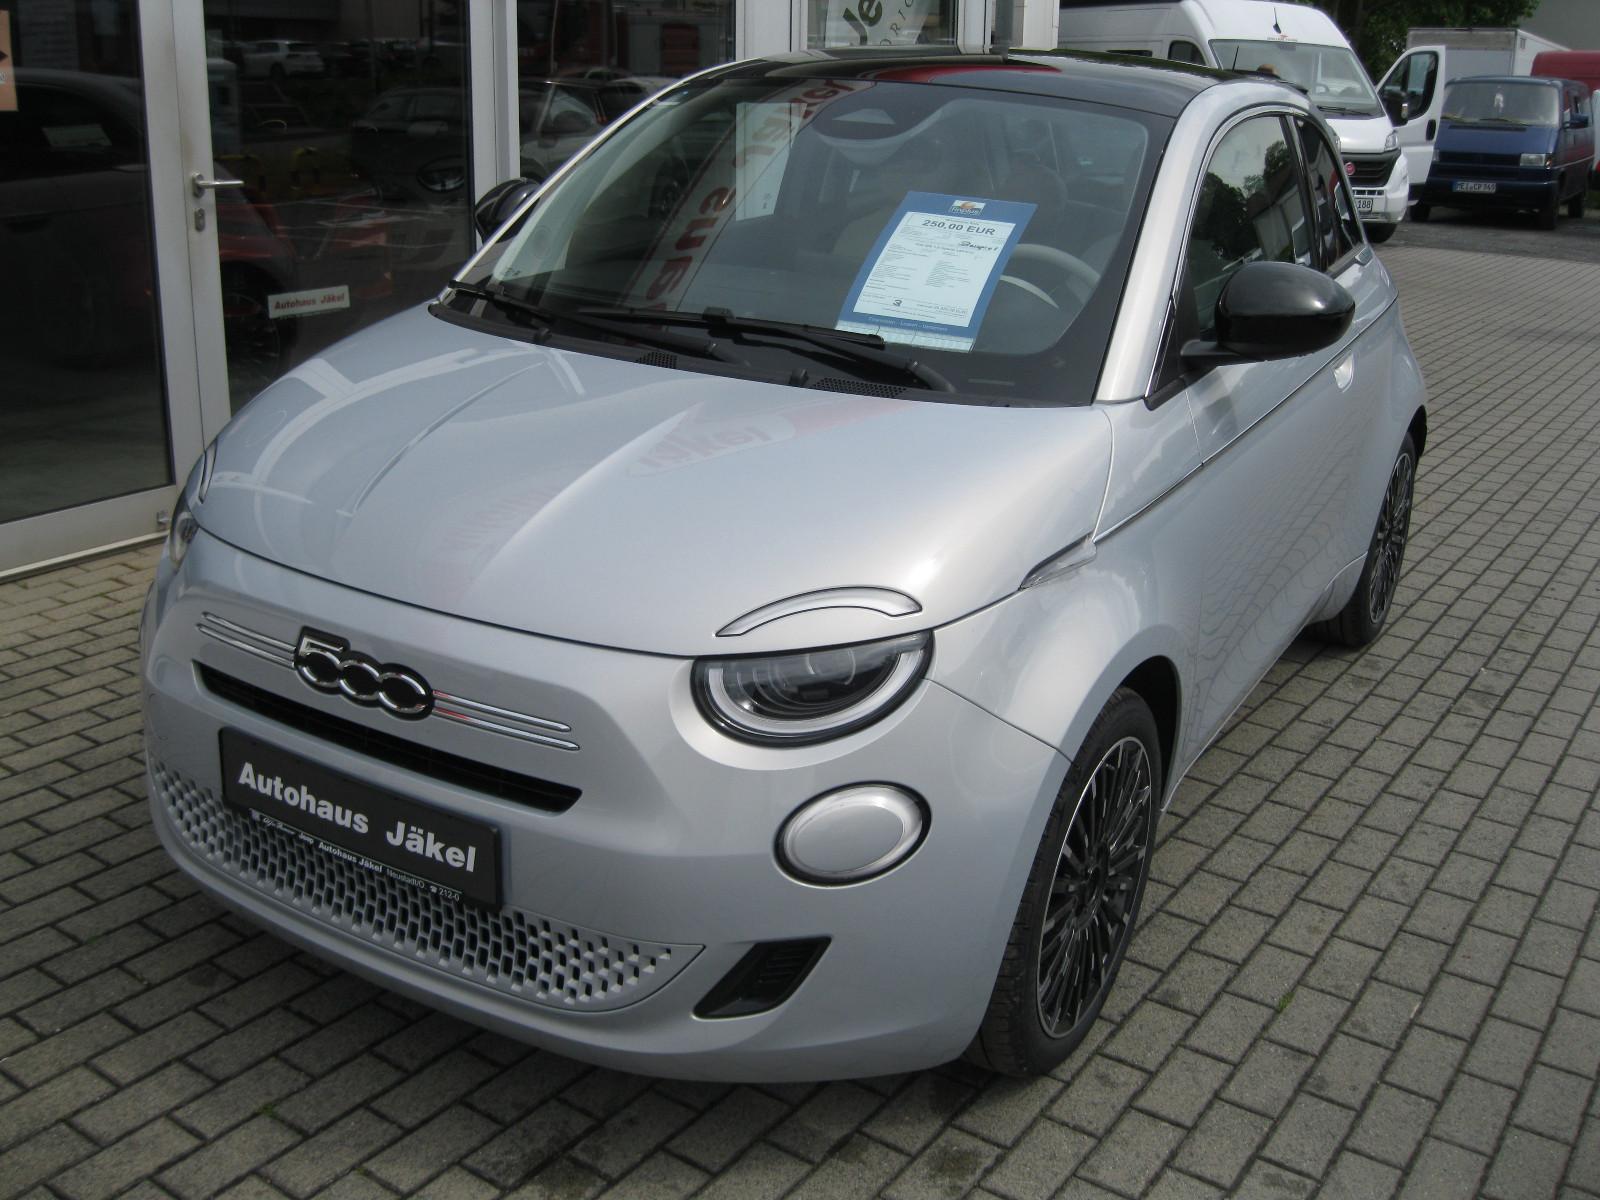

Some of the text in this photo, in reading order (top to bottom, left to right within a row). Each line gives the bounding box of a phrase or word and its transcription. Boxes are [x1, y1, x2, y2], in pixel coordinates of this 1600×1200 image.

[966, 225, 996, 236] EUR
[274, 298, 317, 310] Autohaus
[296, 626, 433, 720] 500
[238, 762, 476, 873] Autohaus Jäkel
[318, 842, 358, 863] Autohaus
